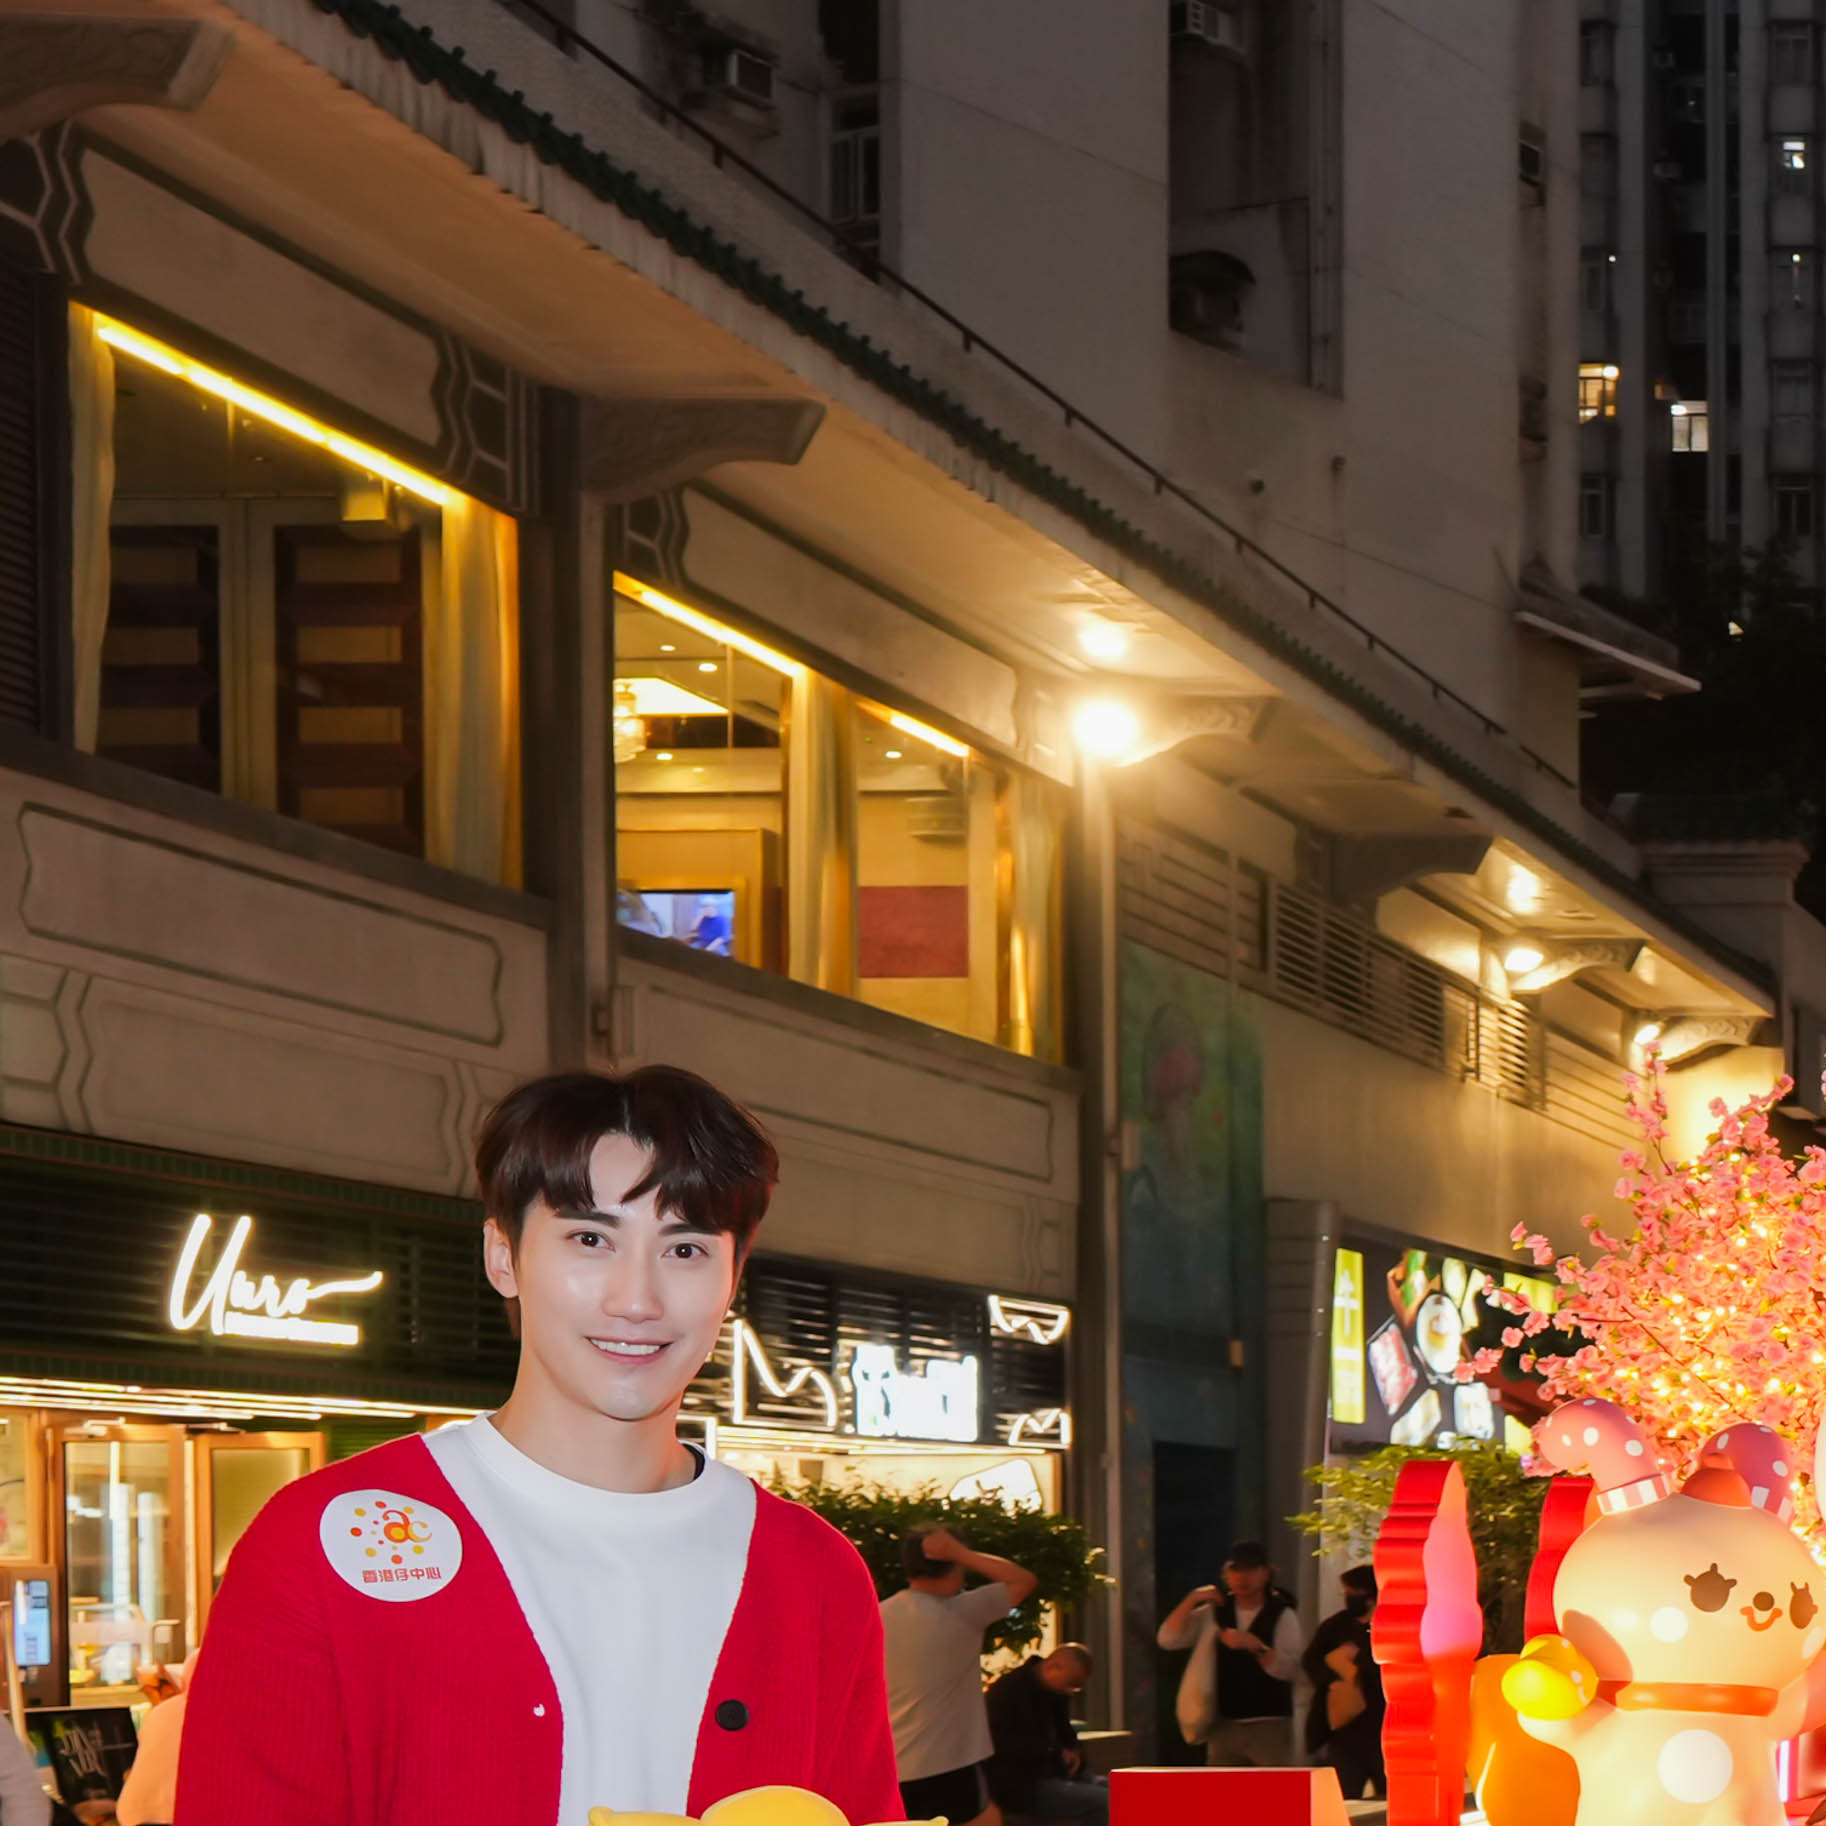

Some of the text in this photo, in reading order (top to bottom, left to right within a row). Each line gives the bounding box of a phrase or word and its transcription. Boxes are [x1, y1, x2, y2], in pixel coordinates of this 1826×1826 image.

[362, 1566, 442, 1584] 香港仔中心
